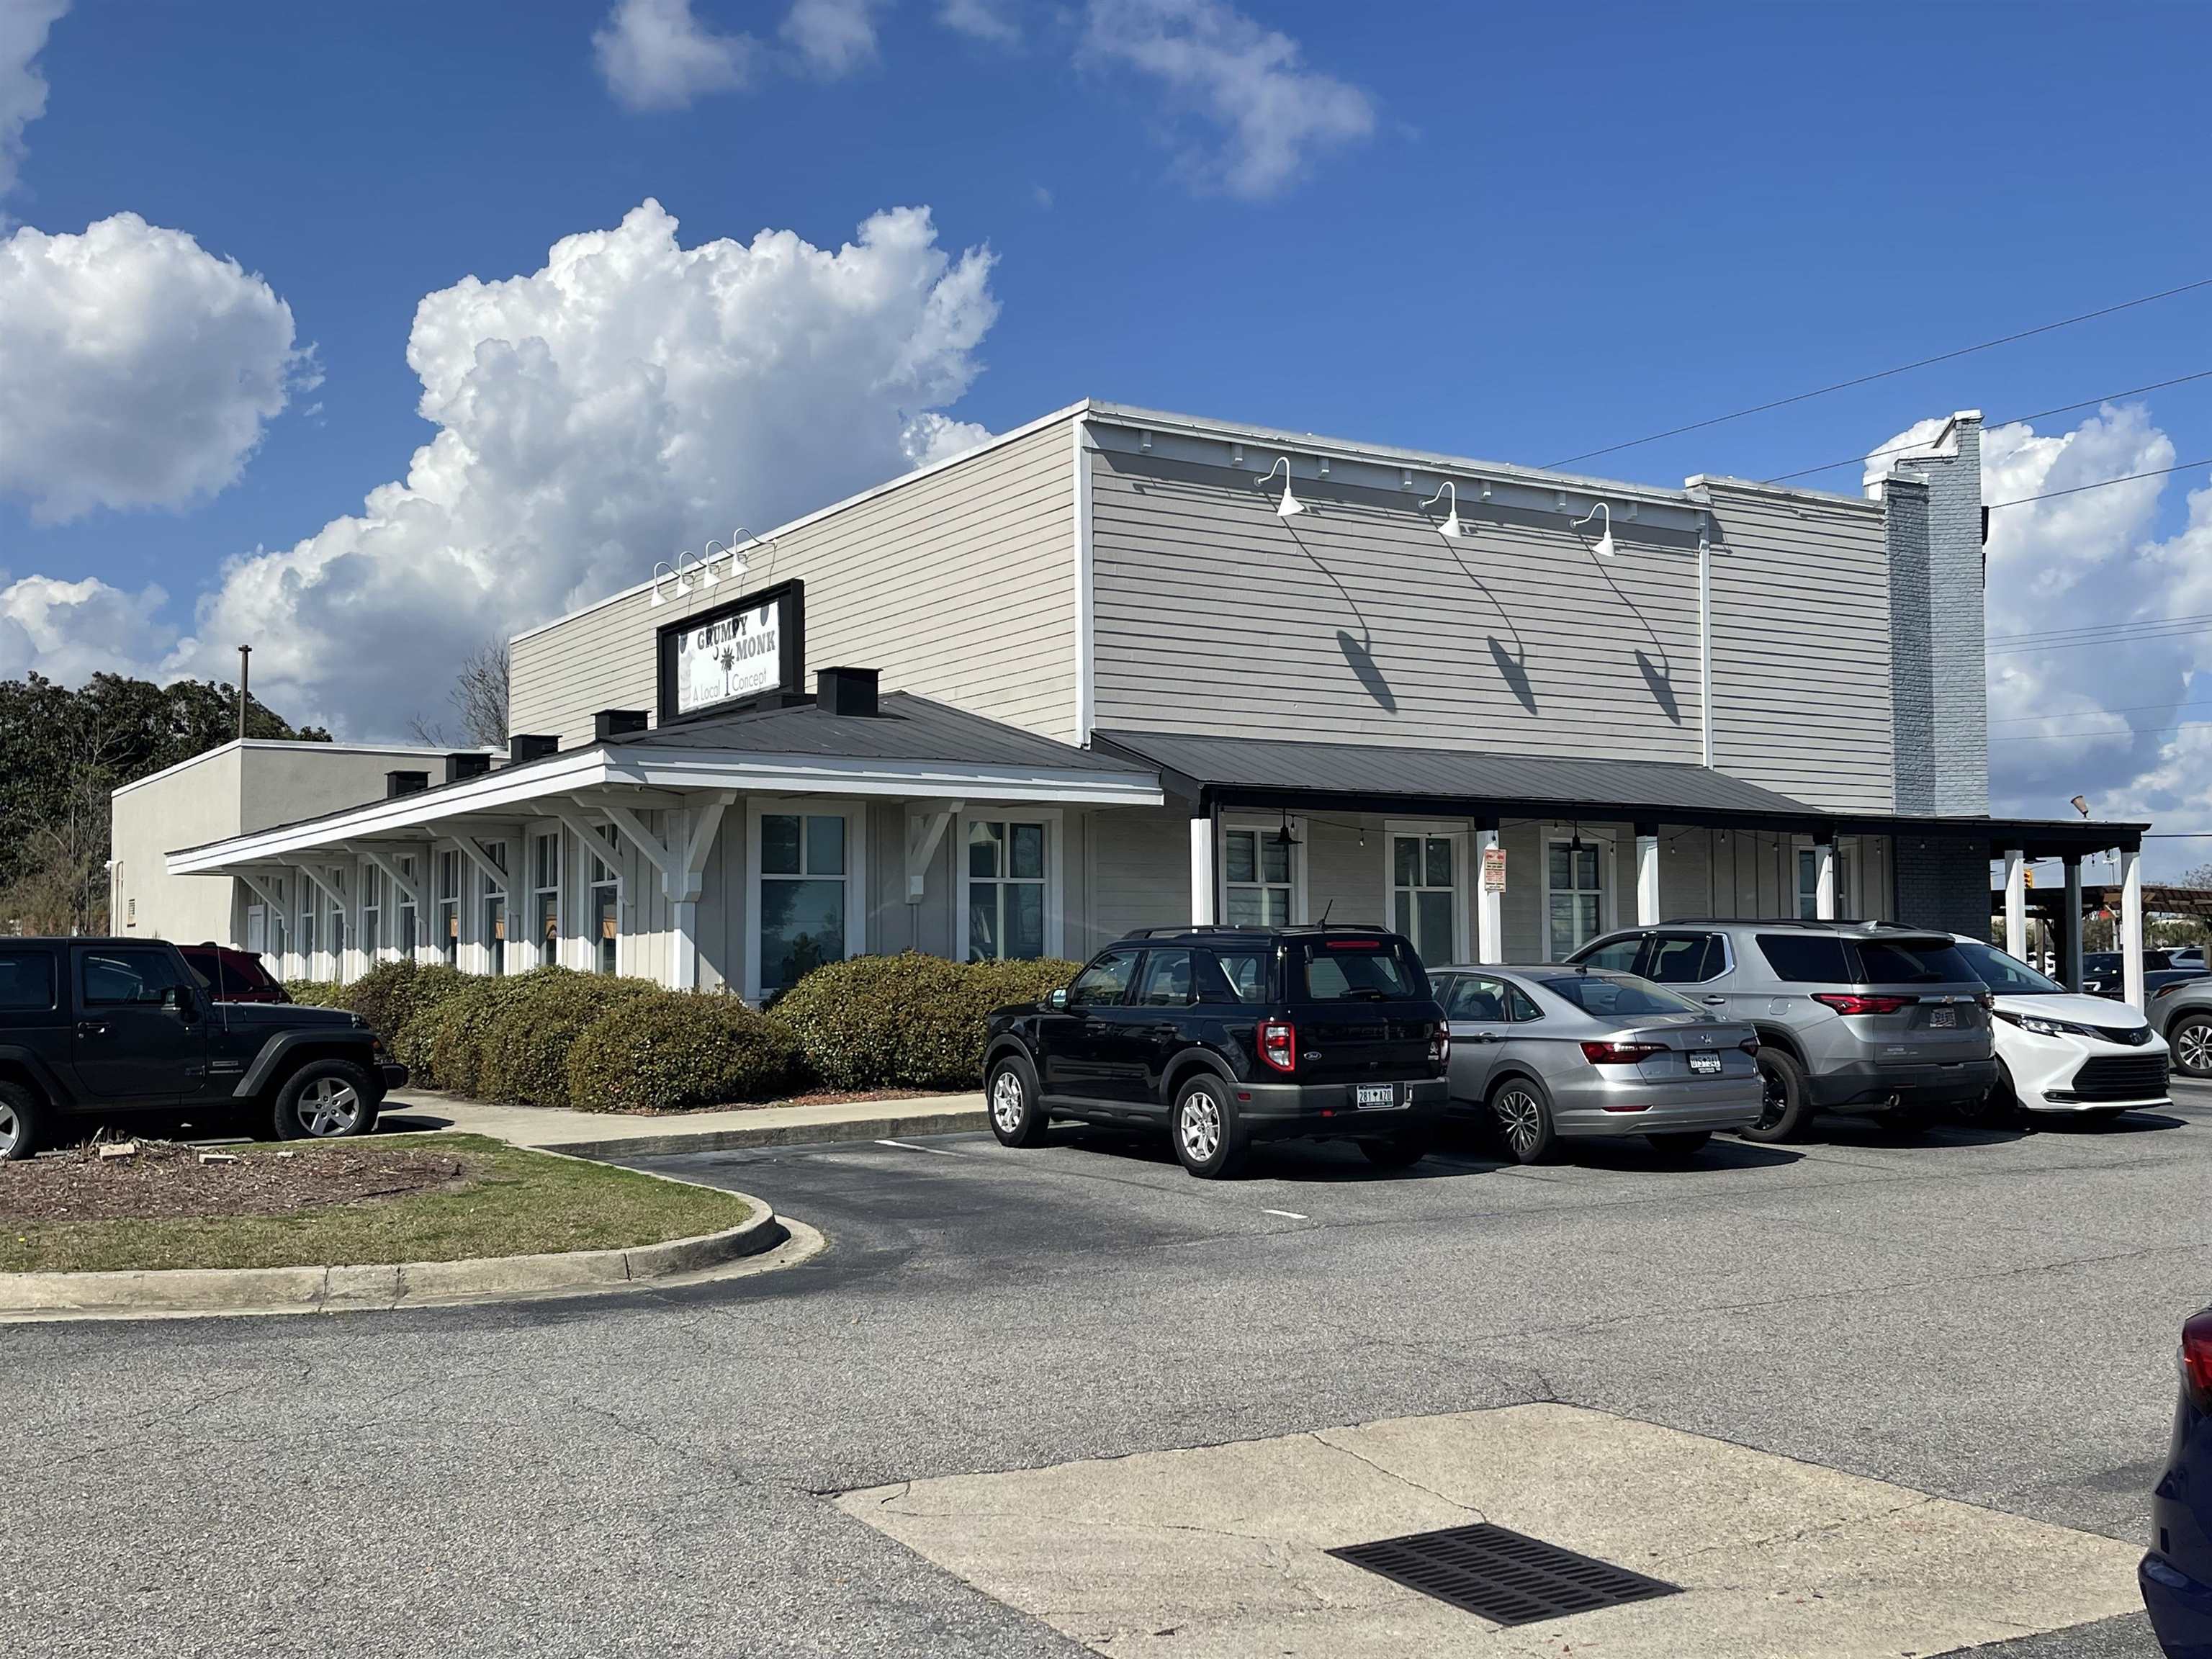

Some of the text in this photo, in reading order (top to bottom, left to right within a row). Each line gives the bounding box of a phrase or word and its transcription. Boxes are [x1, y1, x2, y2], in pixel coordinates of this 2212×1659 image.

[697, 615, 748, 649] GRUMPY
[736, 630, 775, 662] MONK
[693, 668, 766, 703] A Local Concept
[1359, 1091, 1371, 1102] 281
